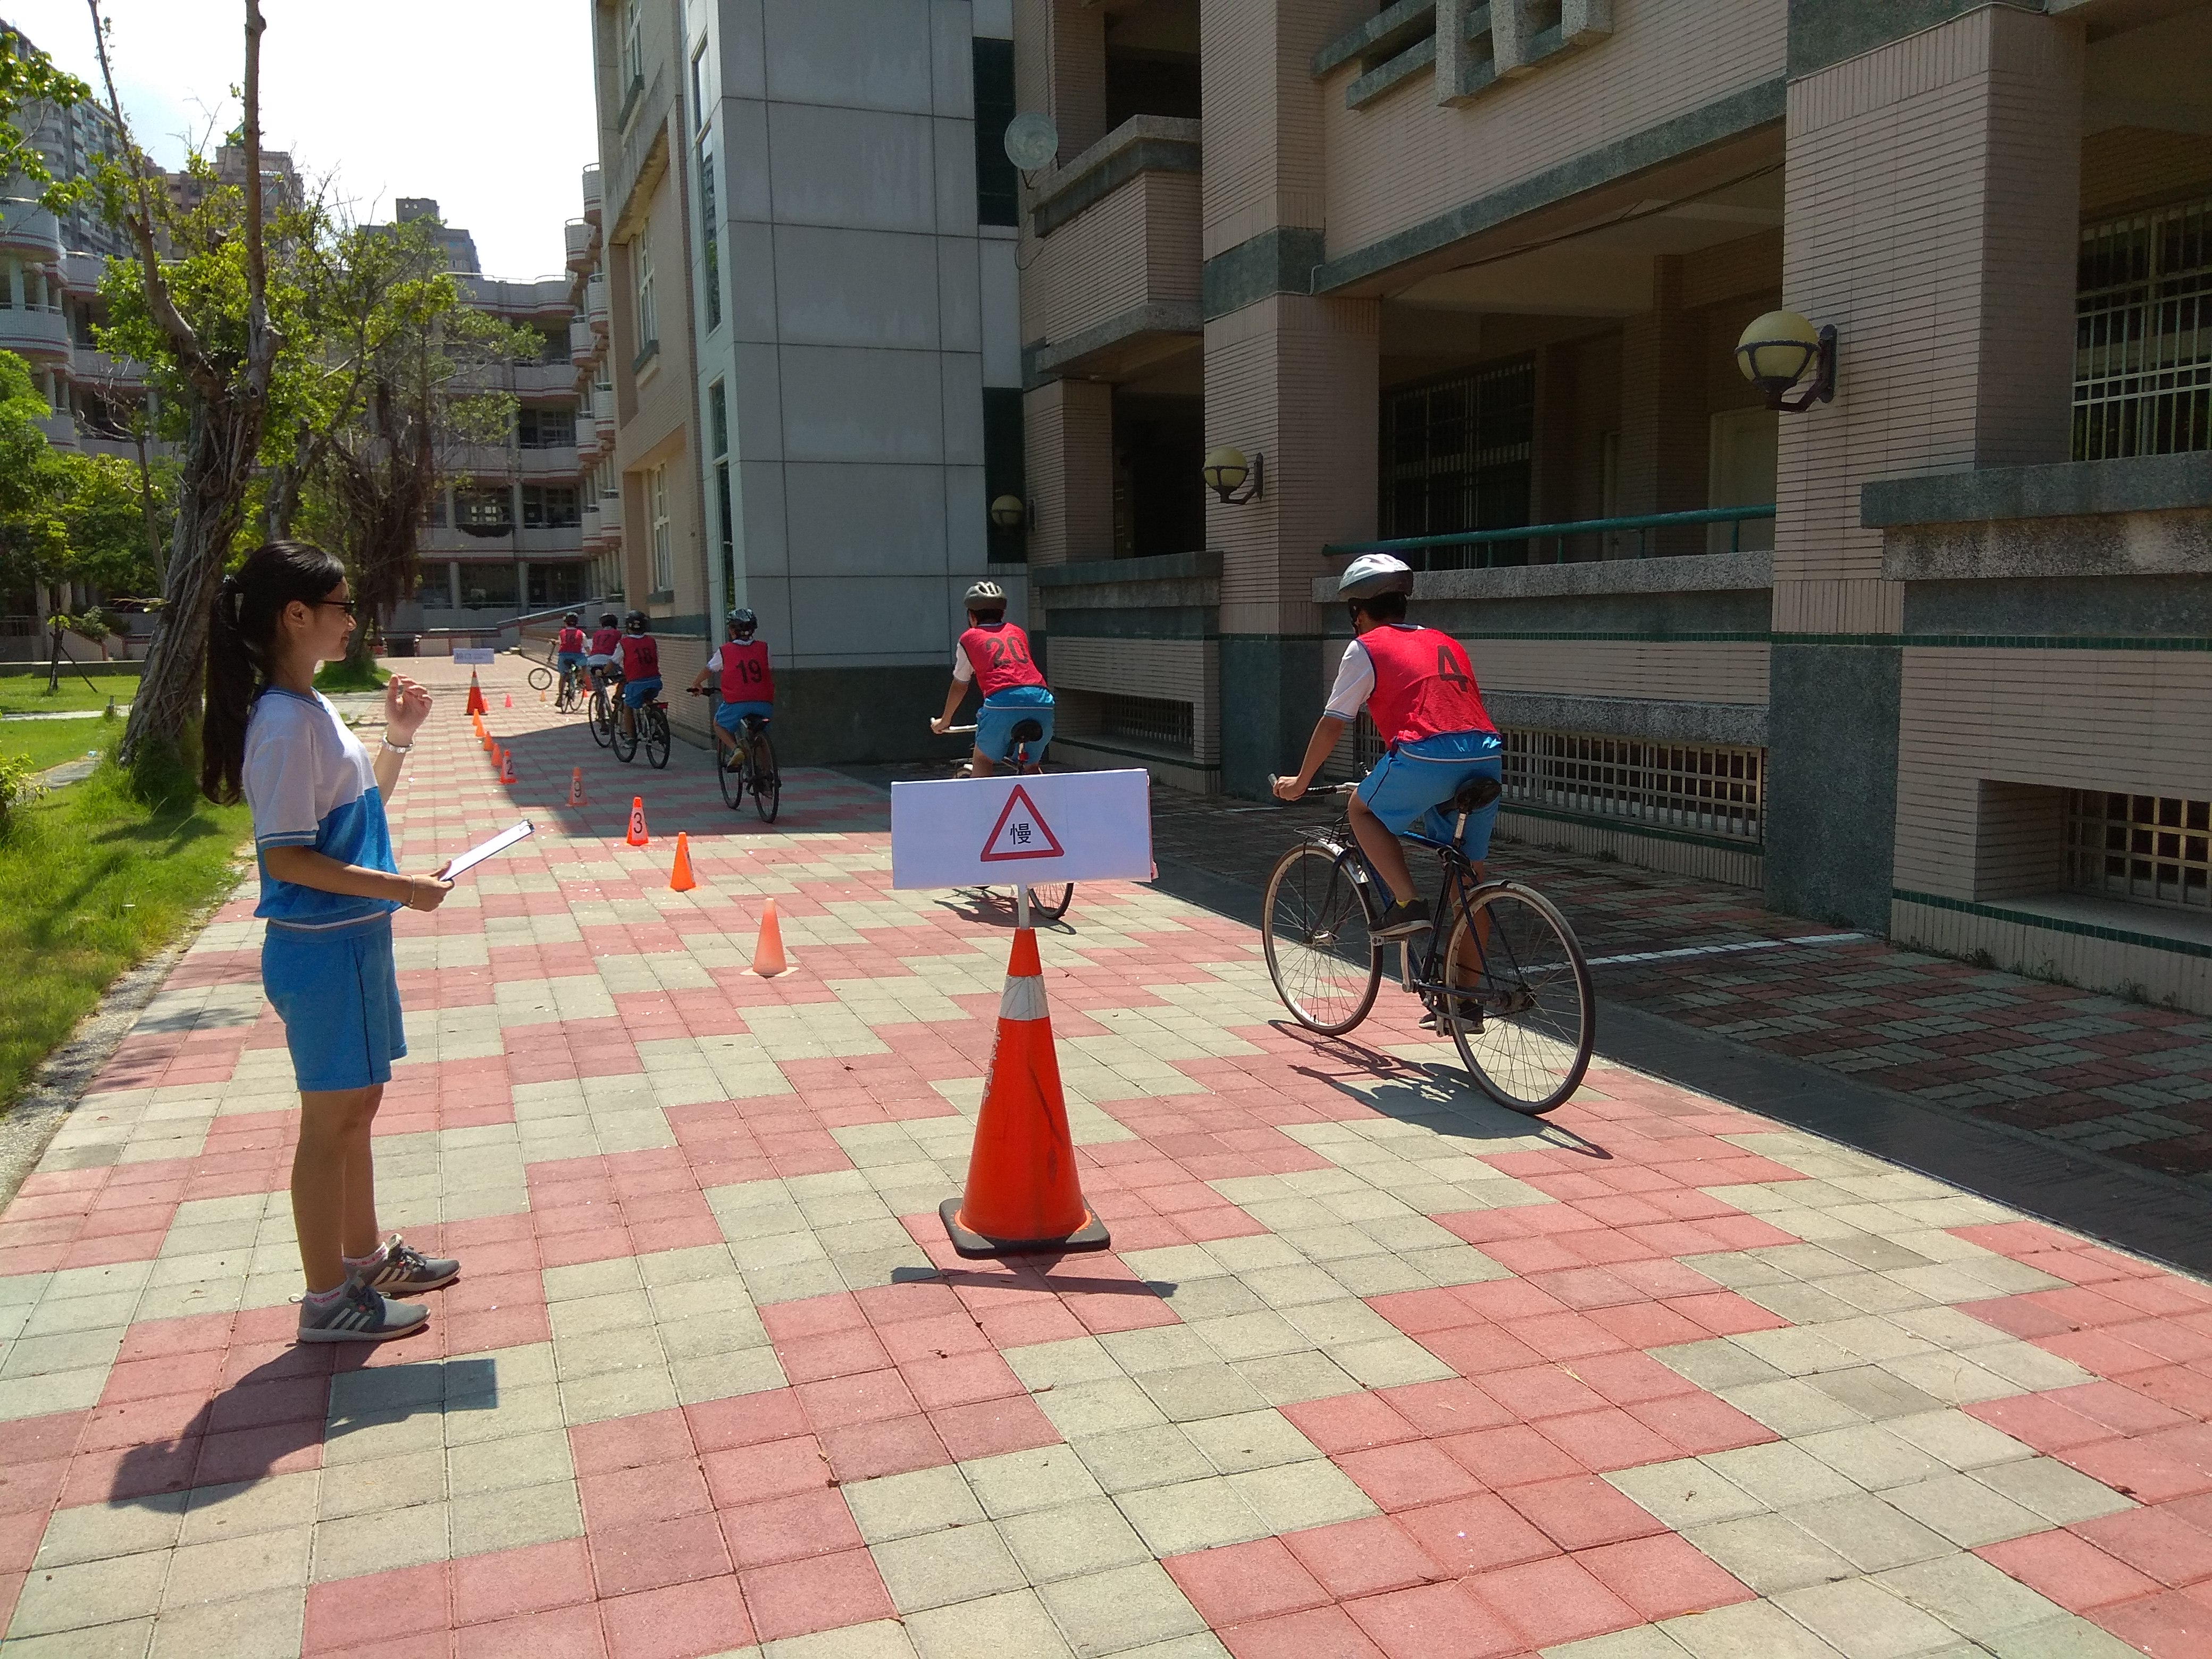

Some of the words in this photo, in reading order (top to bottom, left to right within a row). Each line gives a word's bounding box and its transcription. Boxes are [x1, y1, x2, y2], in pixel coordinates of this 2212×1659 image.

[596, 634, 611, 646] 17
[634, 647, 653, 665] 18
[986, 636, 1028, 669] 20
[735, 659, 761, 683] 19
[1437, 645, 1468, 692] 4
[506, 759, 514, 775] 2
[574, 781, 581, 798] 9
[634, 812, 643, 834] 3
[1010, 823, 1032, 845] 慢
